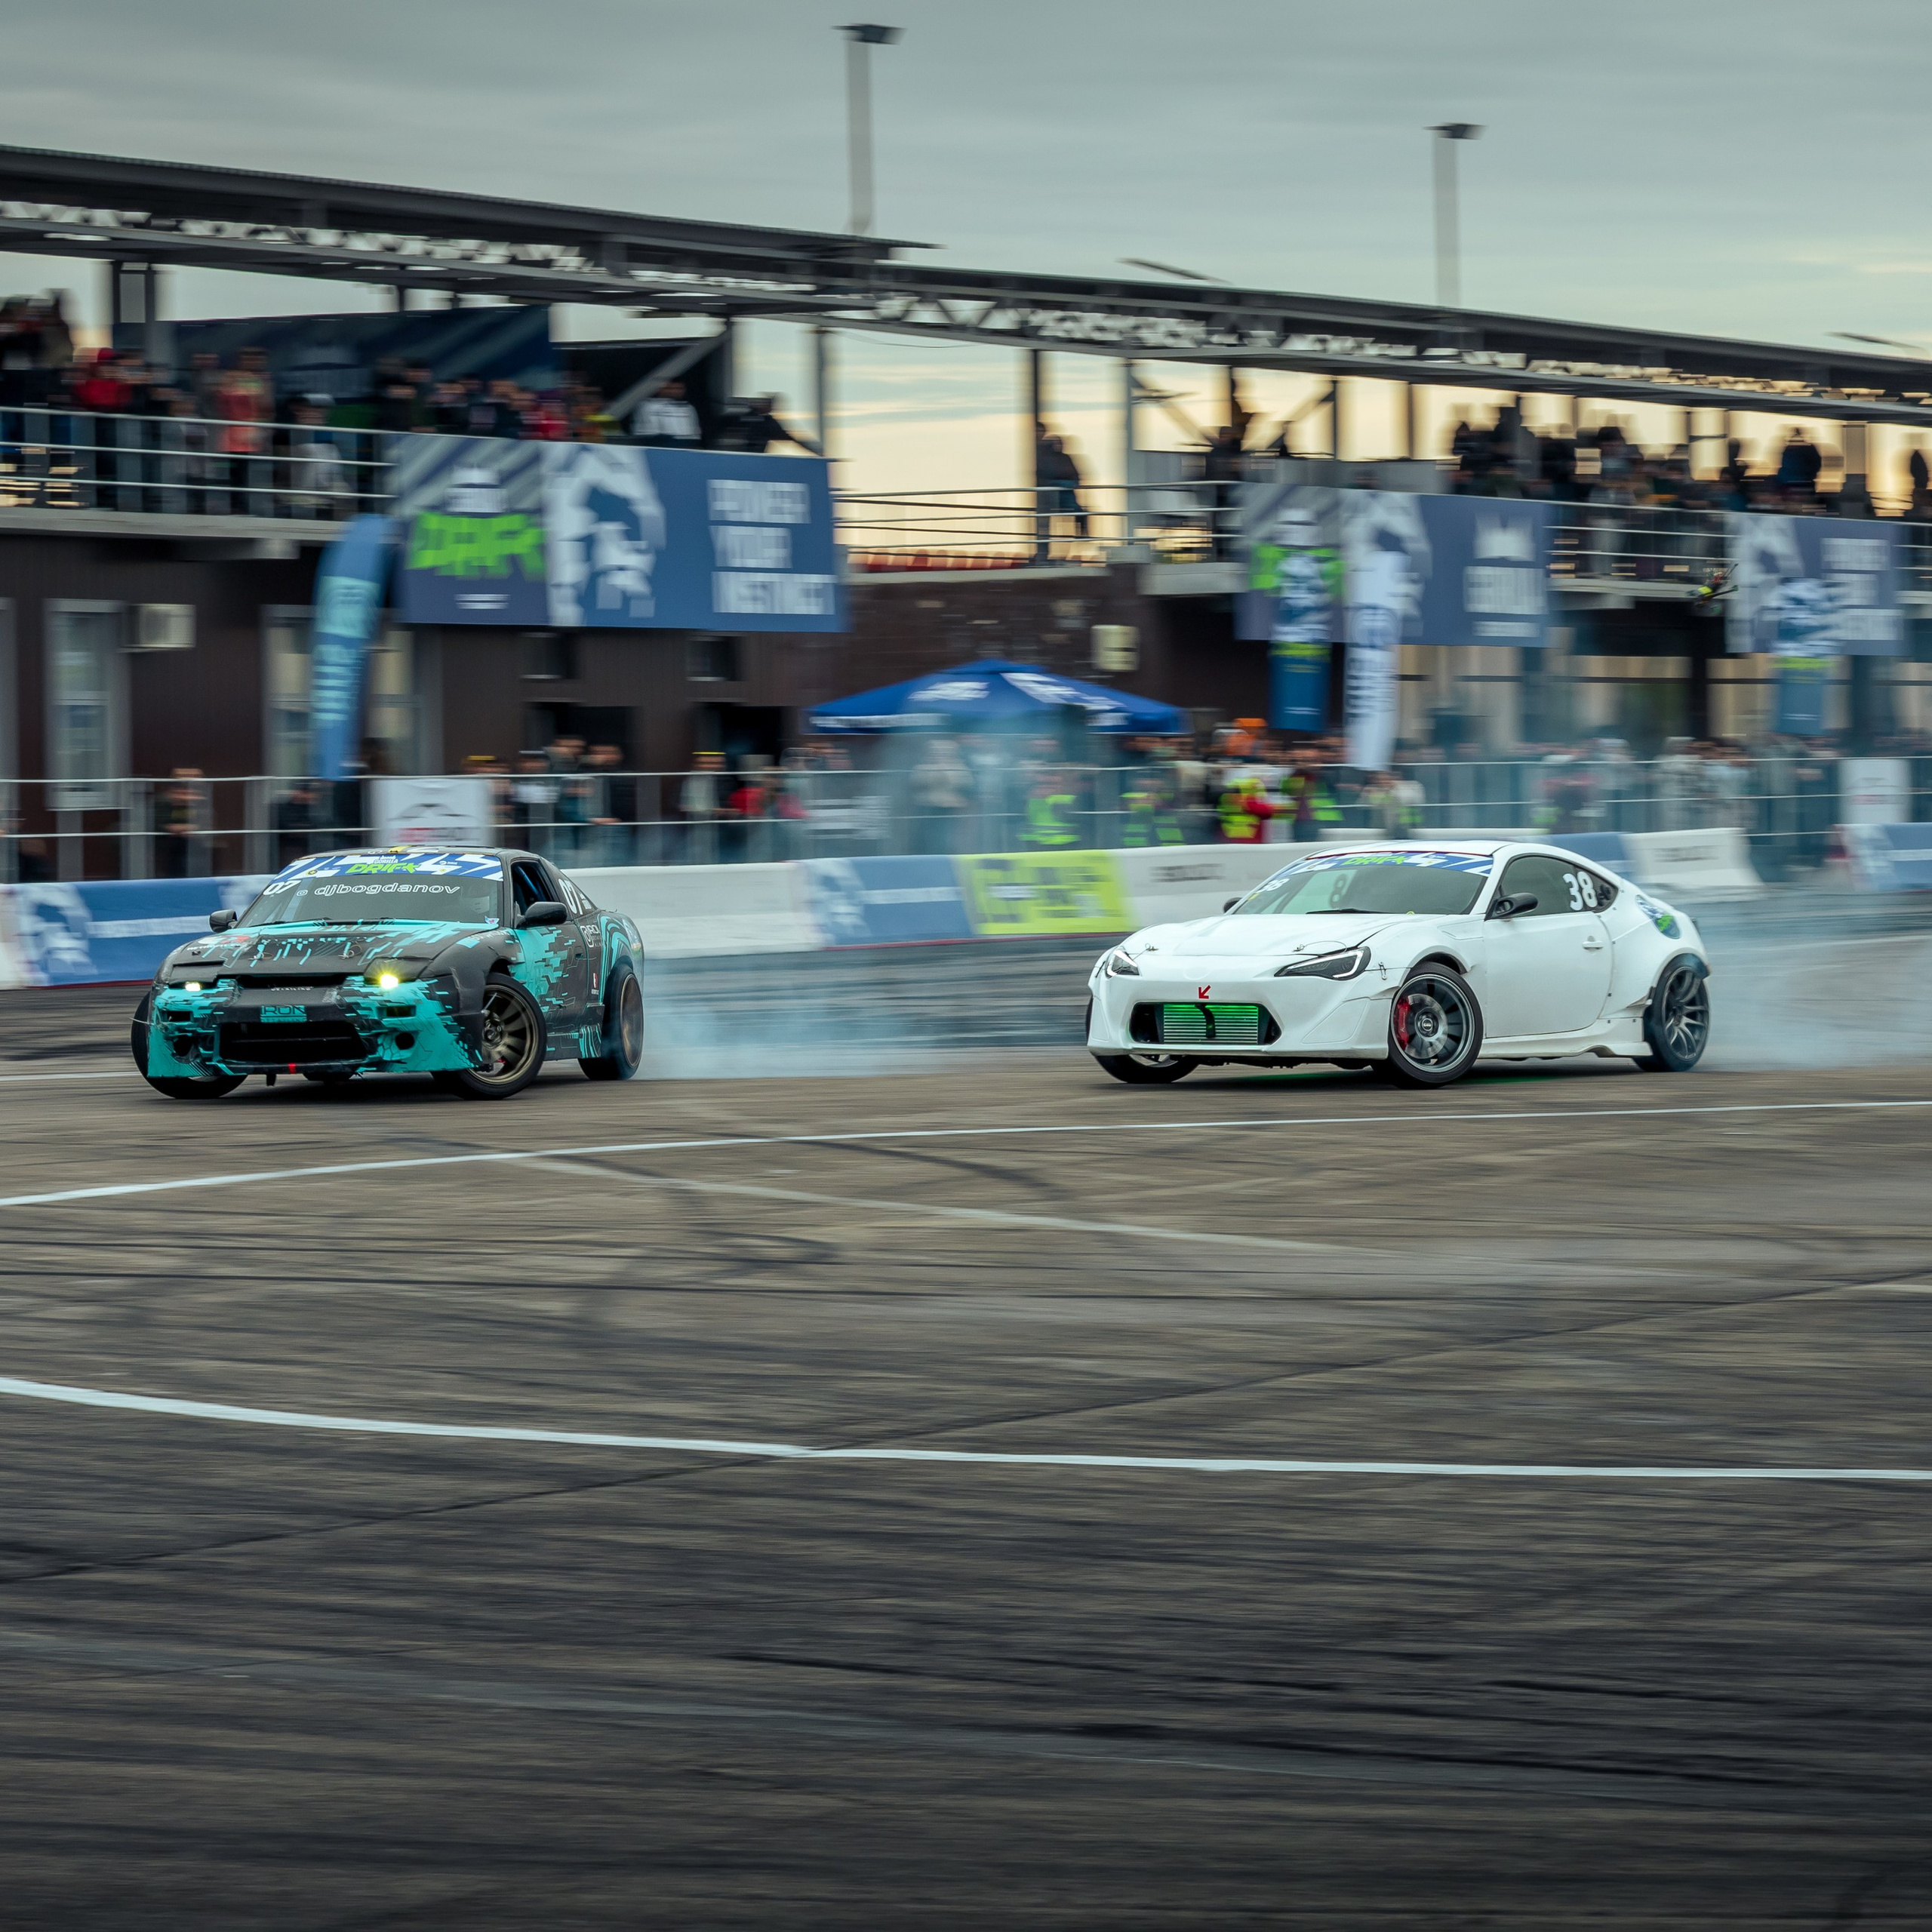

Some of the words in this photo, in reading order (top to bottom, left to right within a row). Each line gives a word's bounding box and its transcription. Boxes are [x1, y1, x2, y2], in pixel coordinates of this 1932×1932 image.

[345, 863, 420, 874] DRIFT
[263, 880, 301, 895] 07
[314, 882, 460, 896] djbogdanov
[1562, 871, 1598, 911] 38
[558, 878, 583, 915] 07
